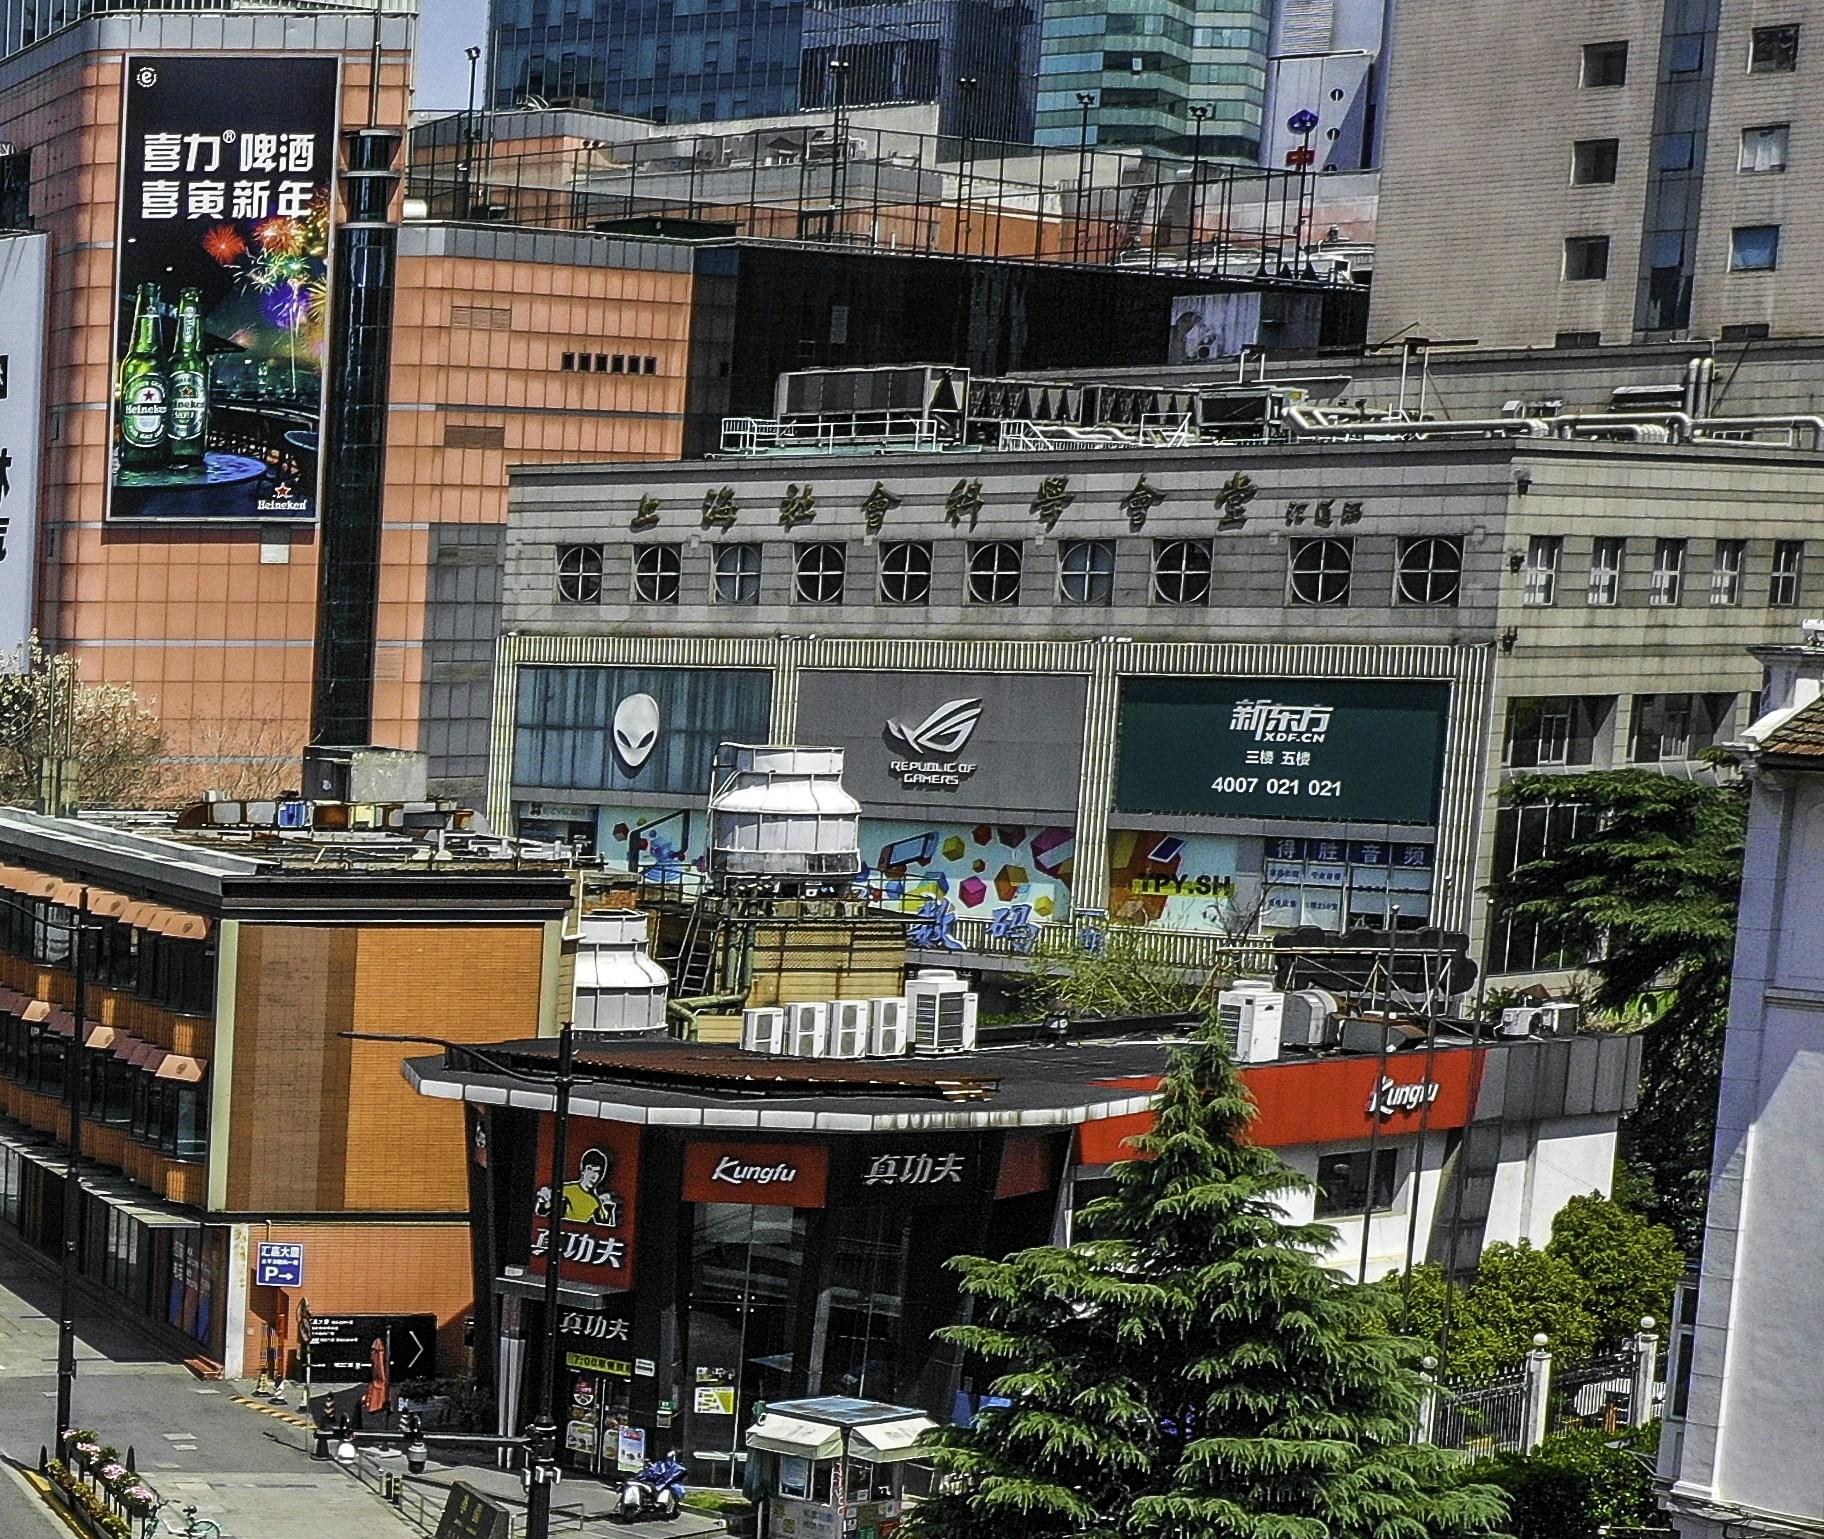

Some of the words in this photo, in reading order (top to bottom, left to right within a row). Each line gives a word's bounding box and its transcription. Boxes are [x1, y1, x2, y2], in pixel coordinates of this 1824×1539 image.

[141, 179, 313, 220] 喜寅新年
[257, 499, 308, 511] Heineken
[1229, 698, 1334, 741] 新东方
[1263, 732, 1326, 743] XDF.CN
[890, 760, 958, 773] REPUBLIC
[958, 763, 978, 774] OF
[1245, 749, 1274, 765] 三楼
[1280, 751, 1311, 766] 五楼
[903, 772, 960, 785] GAMERS
[1211, 776, 1259, 793] 4007
[1266, 778, 1300, 795] 021
[1308, 779, 1342, 797] 021
[1277, 838, 1425, 866] 得胜音频
[1140, 873, 1231, 897] TPY.SH
[711, 1156, 797, 1184] Kungfu
[863, 1153, 967, 1186] 真功夫
[531, 1228, 625, 1269] 真功夫
[265, 1266, 278, 1281] P
[558, 1311, 630, 1342] 真功夫
